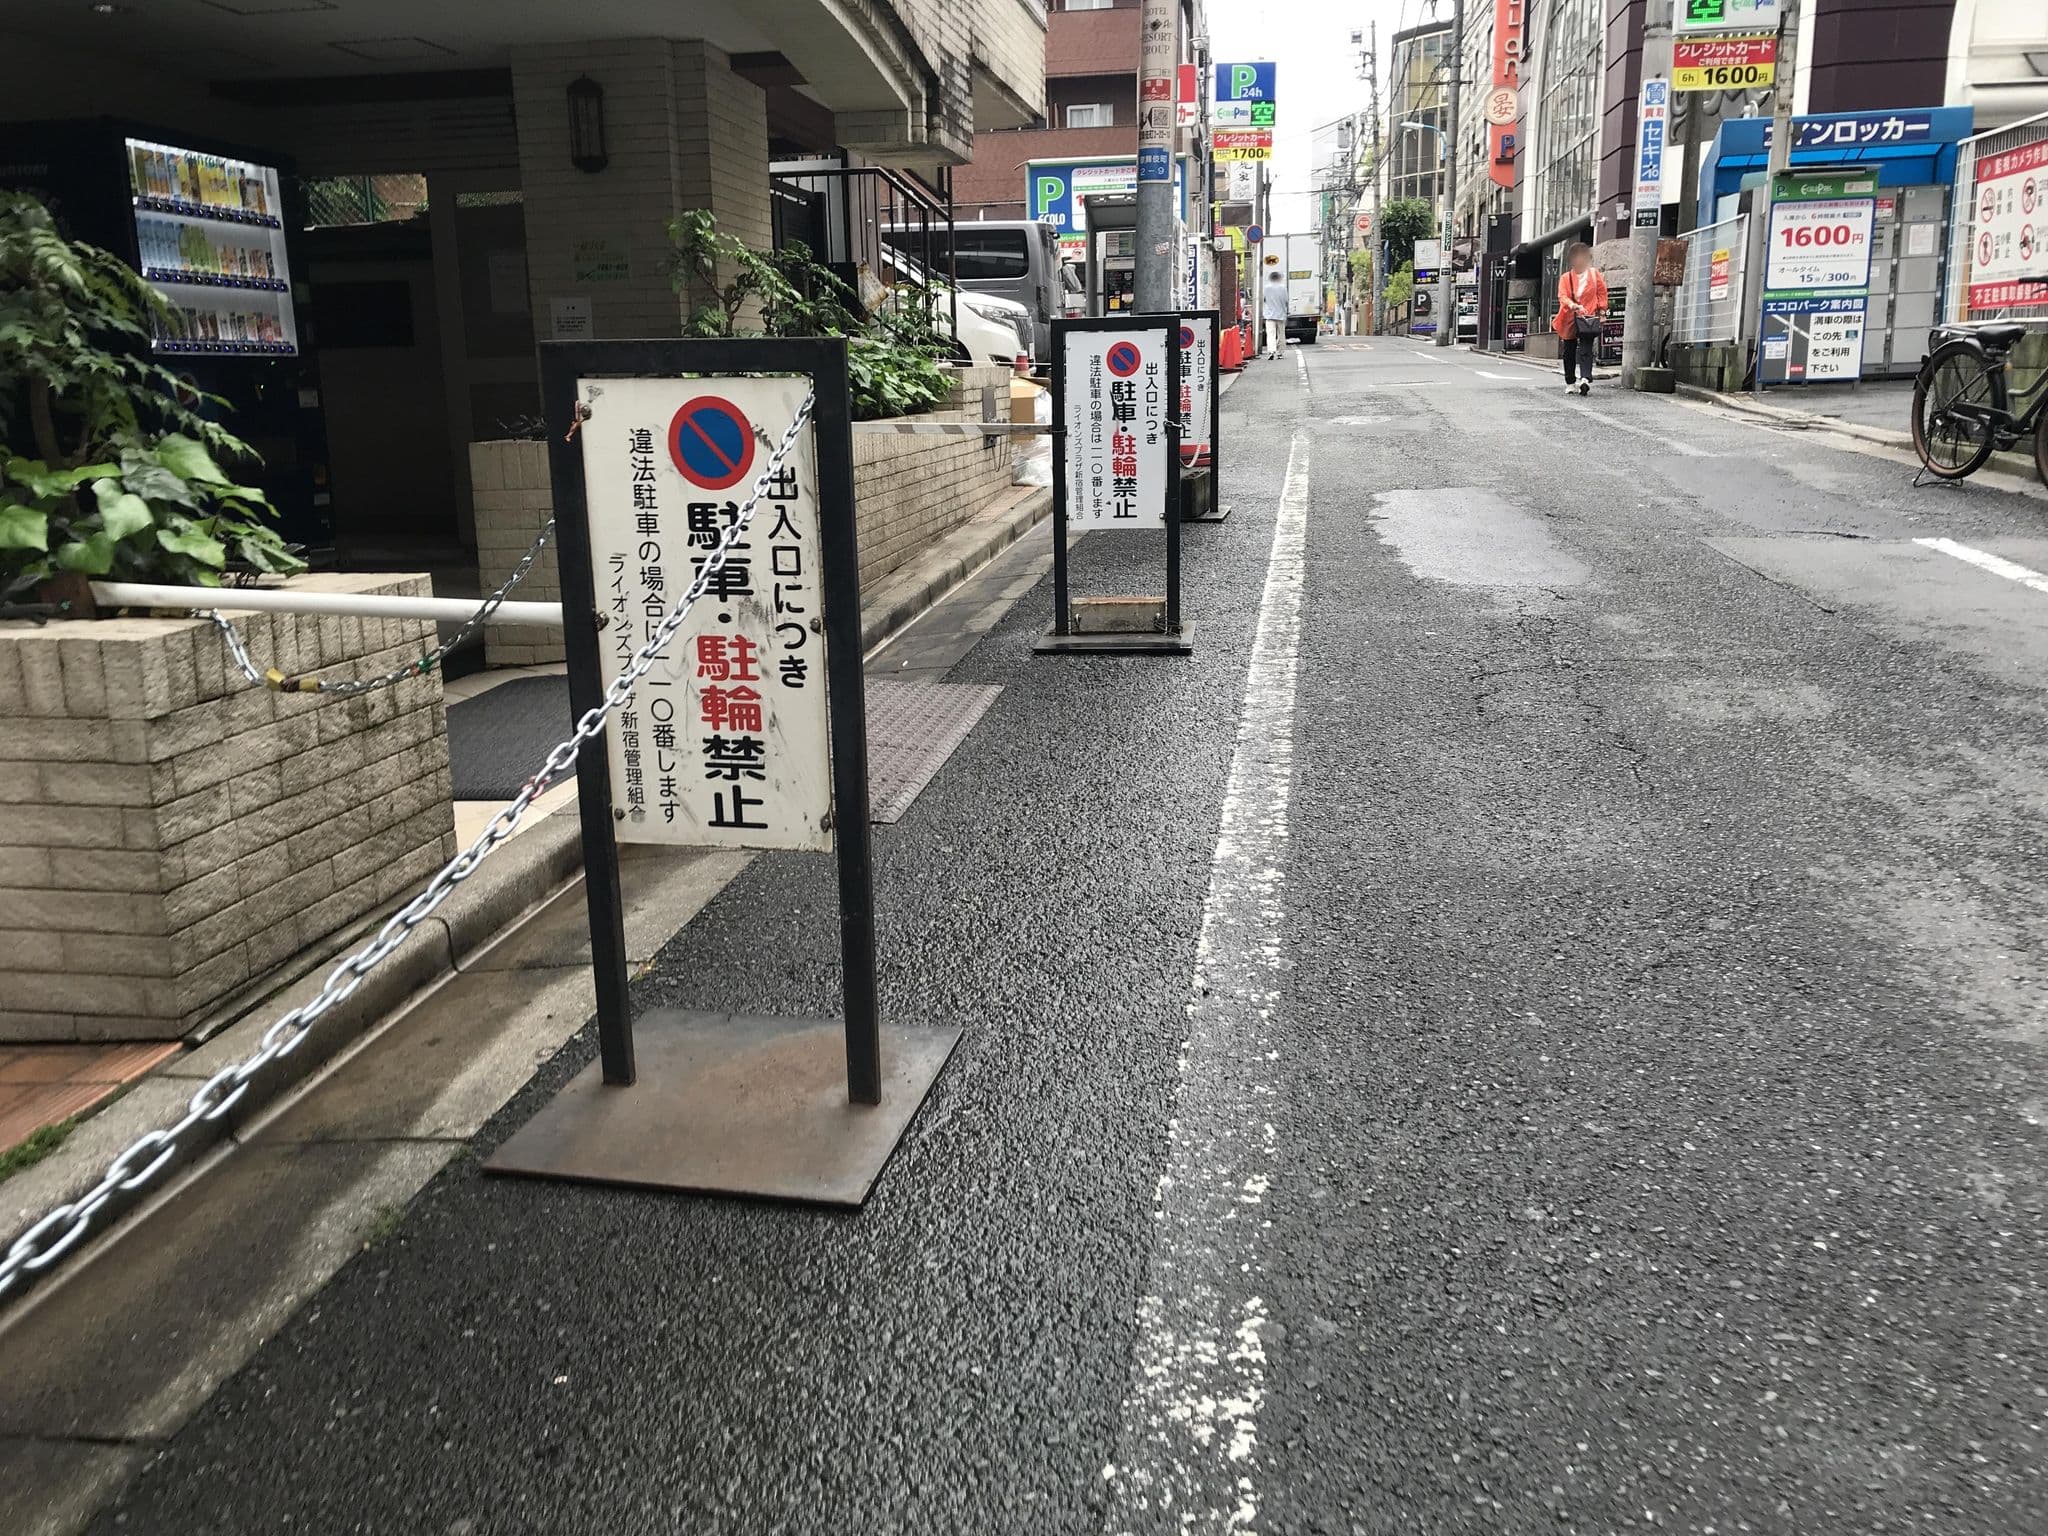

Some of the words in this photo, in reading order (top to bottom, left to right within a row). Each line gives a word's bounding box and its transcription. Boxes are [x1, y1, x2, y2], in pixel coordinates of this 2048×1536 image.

[1679, 41, 1772, 57] クレジットカード
[1232, 65, 1257, 98] P
[1704, 66, 1768, 85] 1600円
[1242, 87, 1263, 98] 24h
[1252, 101, 1275, 126] 空
[1642, 123, 1660, 178] セキネ
[1037, 177, 1065, 213] P
[1781, 225, 1864, 247] 1600円
[1417, 294, 1427, 306] P
[1766, 298, 1864, 311] エコロパーク案内図
[1814, 315, 1862, 325] 満車の際は
[1813, 331, 1842, 340] この先
[1812, 347, 1850, 357] をご利用
[1810, 364, 1839, 373] 下さい
[1145, 362, 1159, 445] 出入口につき
[761, 466, 808, 689] 出入口につき
